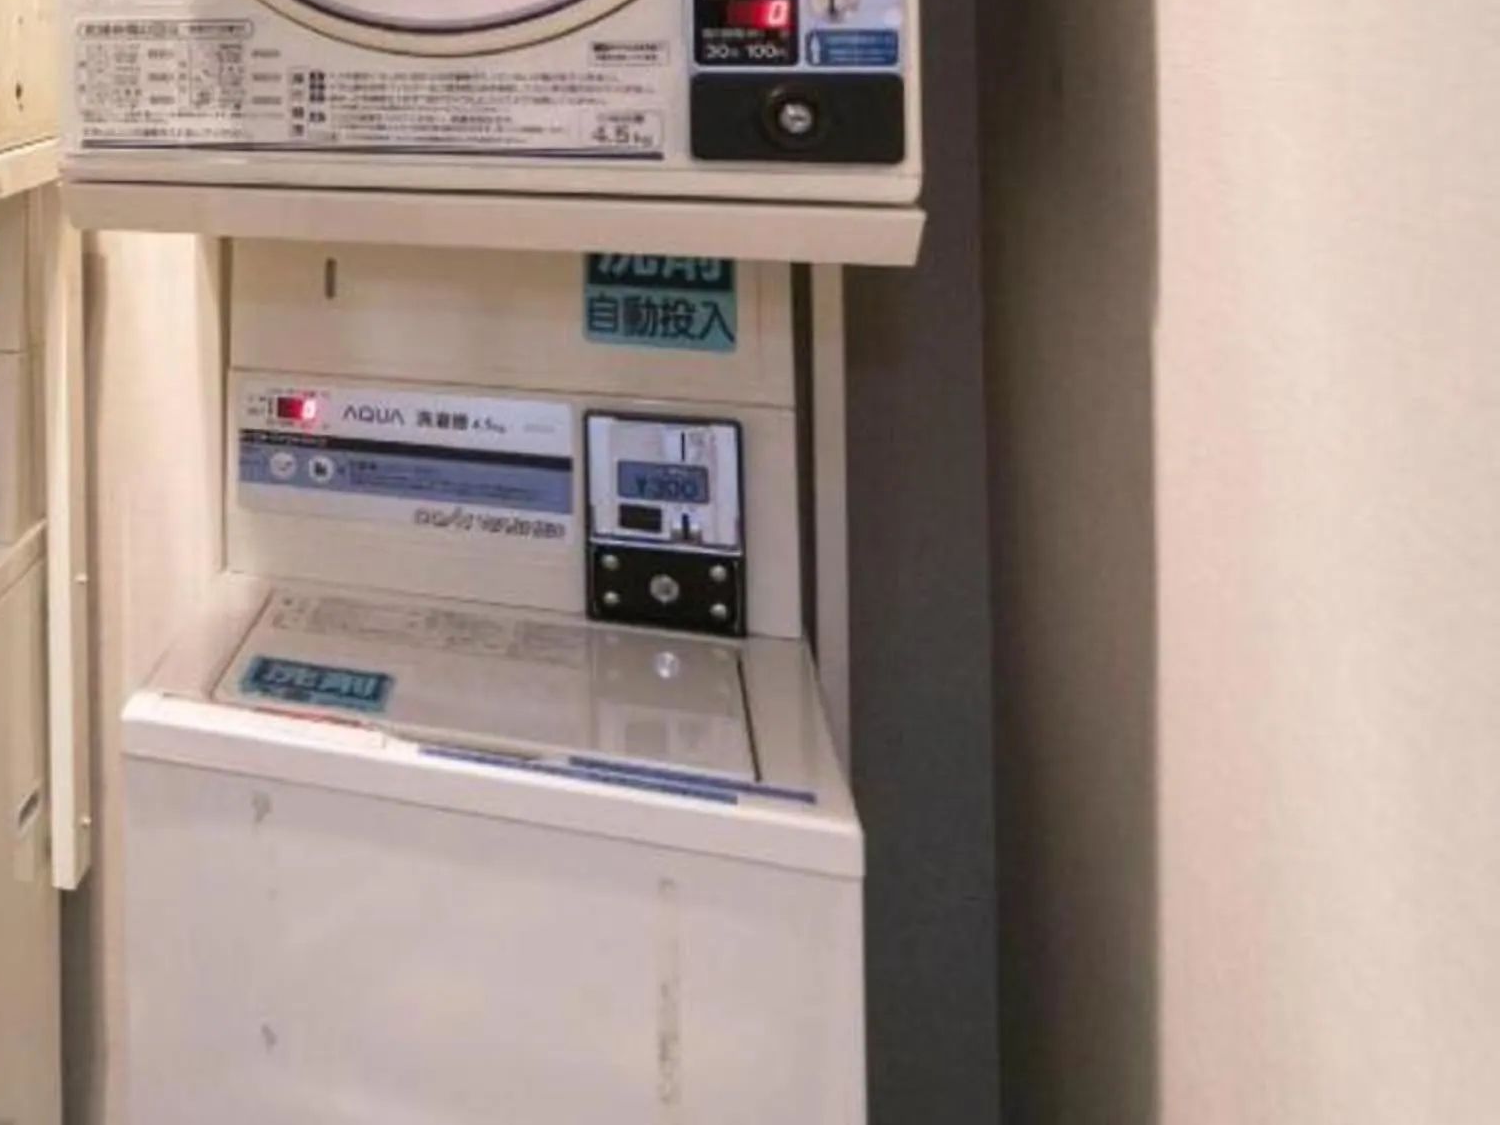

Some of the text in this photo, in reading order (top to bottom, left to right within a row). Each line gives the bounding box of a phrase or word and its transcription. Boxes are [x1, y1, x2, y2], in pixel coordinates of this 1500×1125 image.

[767, 0, 790, 26] 0
[587, 290, 736, 344] 自動投入
[343, 405, 406, 426] AQUA
